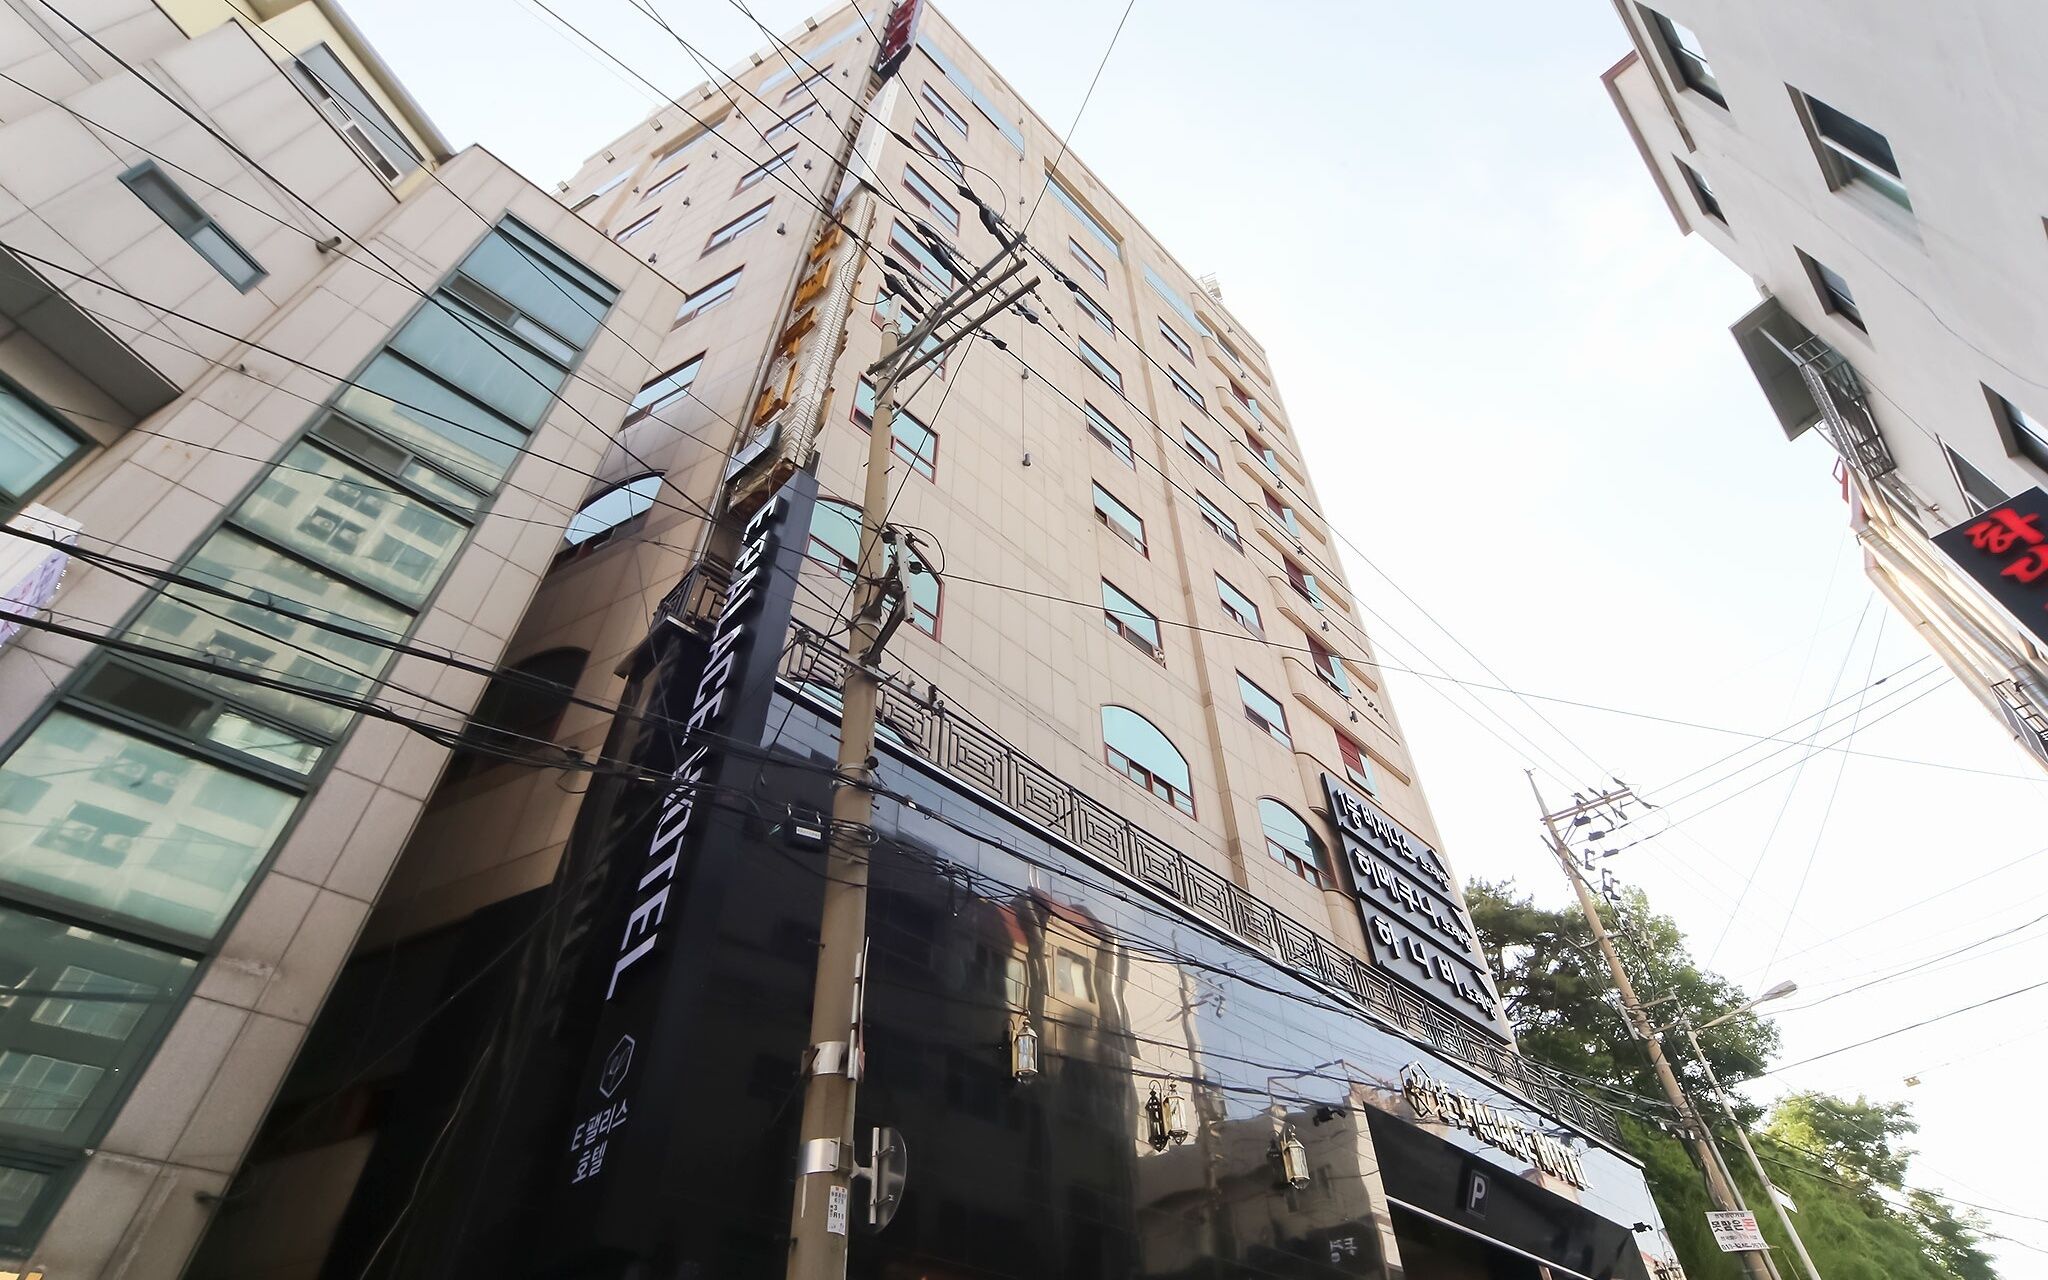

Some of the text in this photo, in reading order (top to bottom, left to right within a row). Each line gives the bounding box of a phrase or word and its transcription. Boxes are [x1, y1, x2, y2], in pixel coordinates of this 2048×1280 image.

[606, 494, 779, 1001] E PALACE HOTEL
[571, 1139, 609, 1184] 호텔
[1471, 1176, 1486, 1209] P
